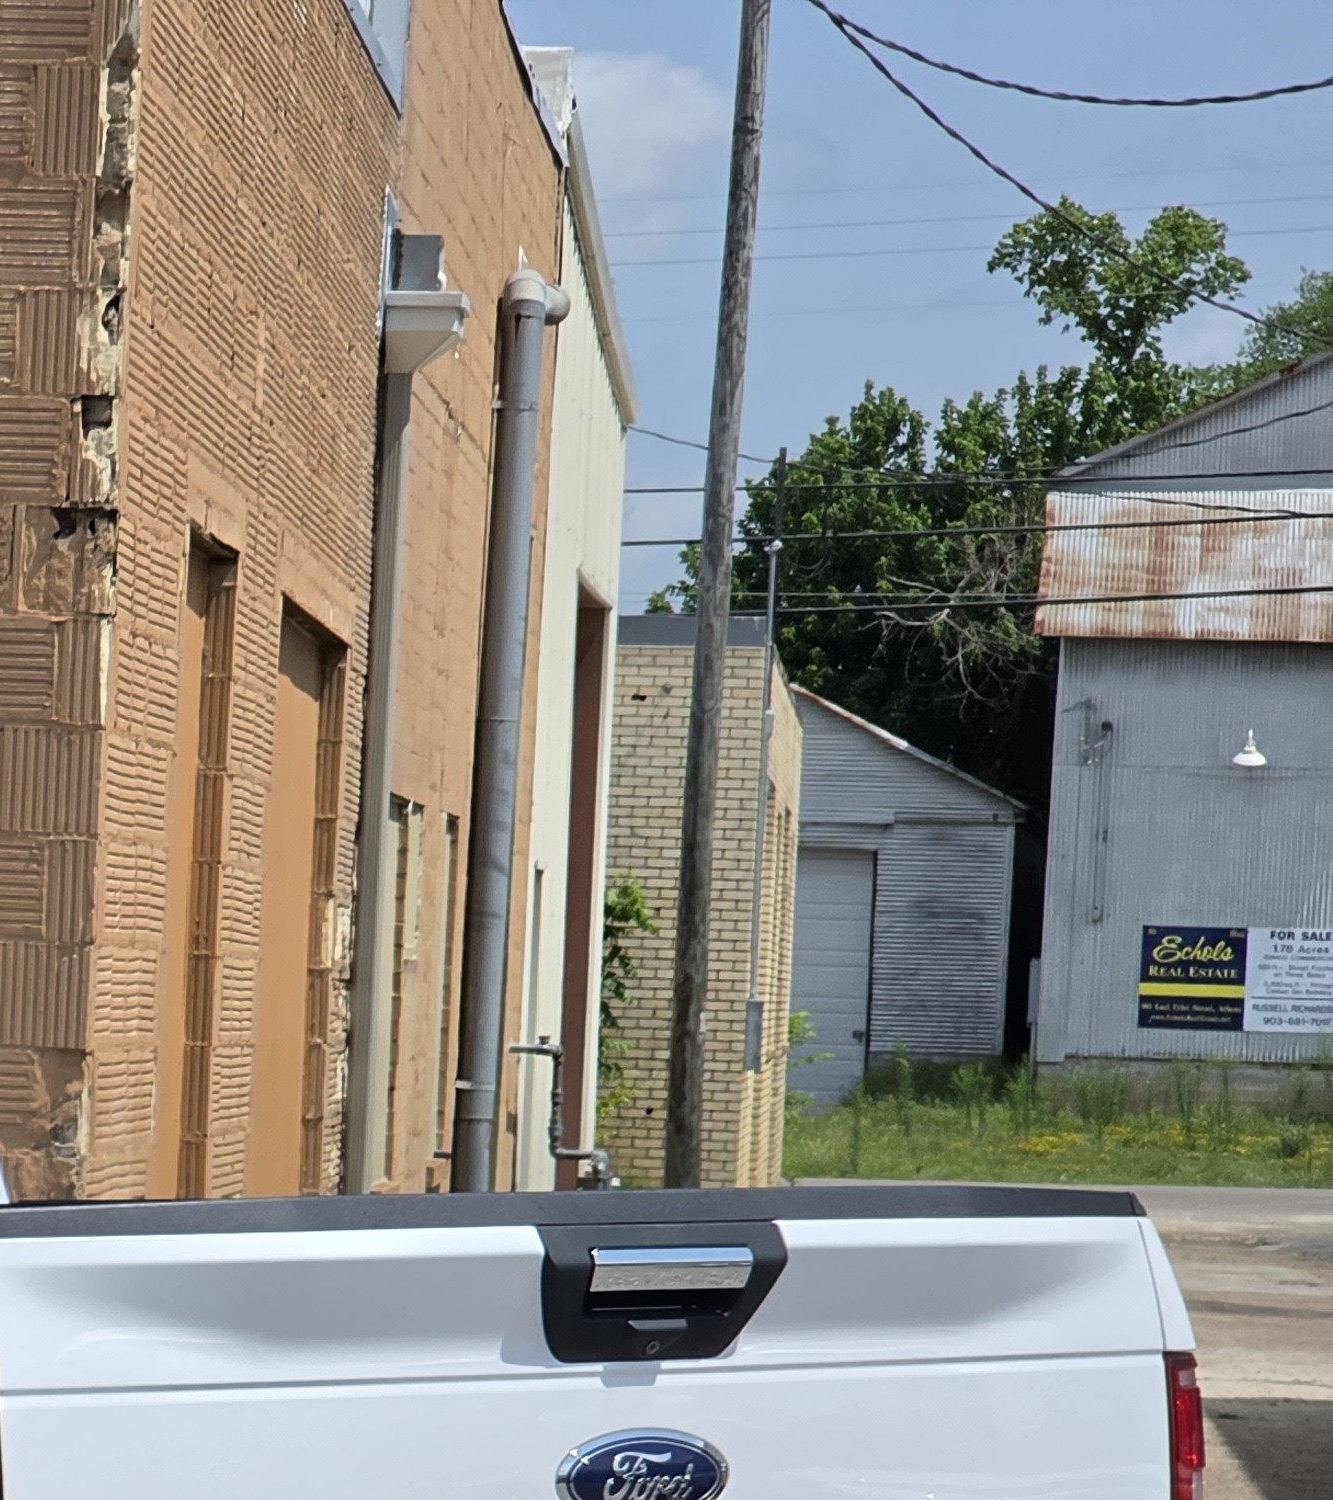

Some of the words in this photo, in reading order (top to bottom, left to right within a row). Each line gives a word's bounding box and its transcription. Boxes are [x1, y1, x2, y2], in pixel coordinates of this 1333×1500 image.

[1270, 930, 1295, 941] FOR
[1301, 931, 1332, 942] SALE
[1152, 935, 1234, 963] Echols
[1148, 964, 1184, 977] REAL
[1188, 966, 1238, 979] ESTATE
